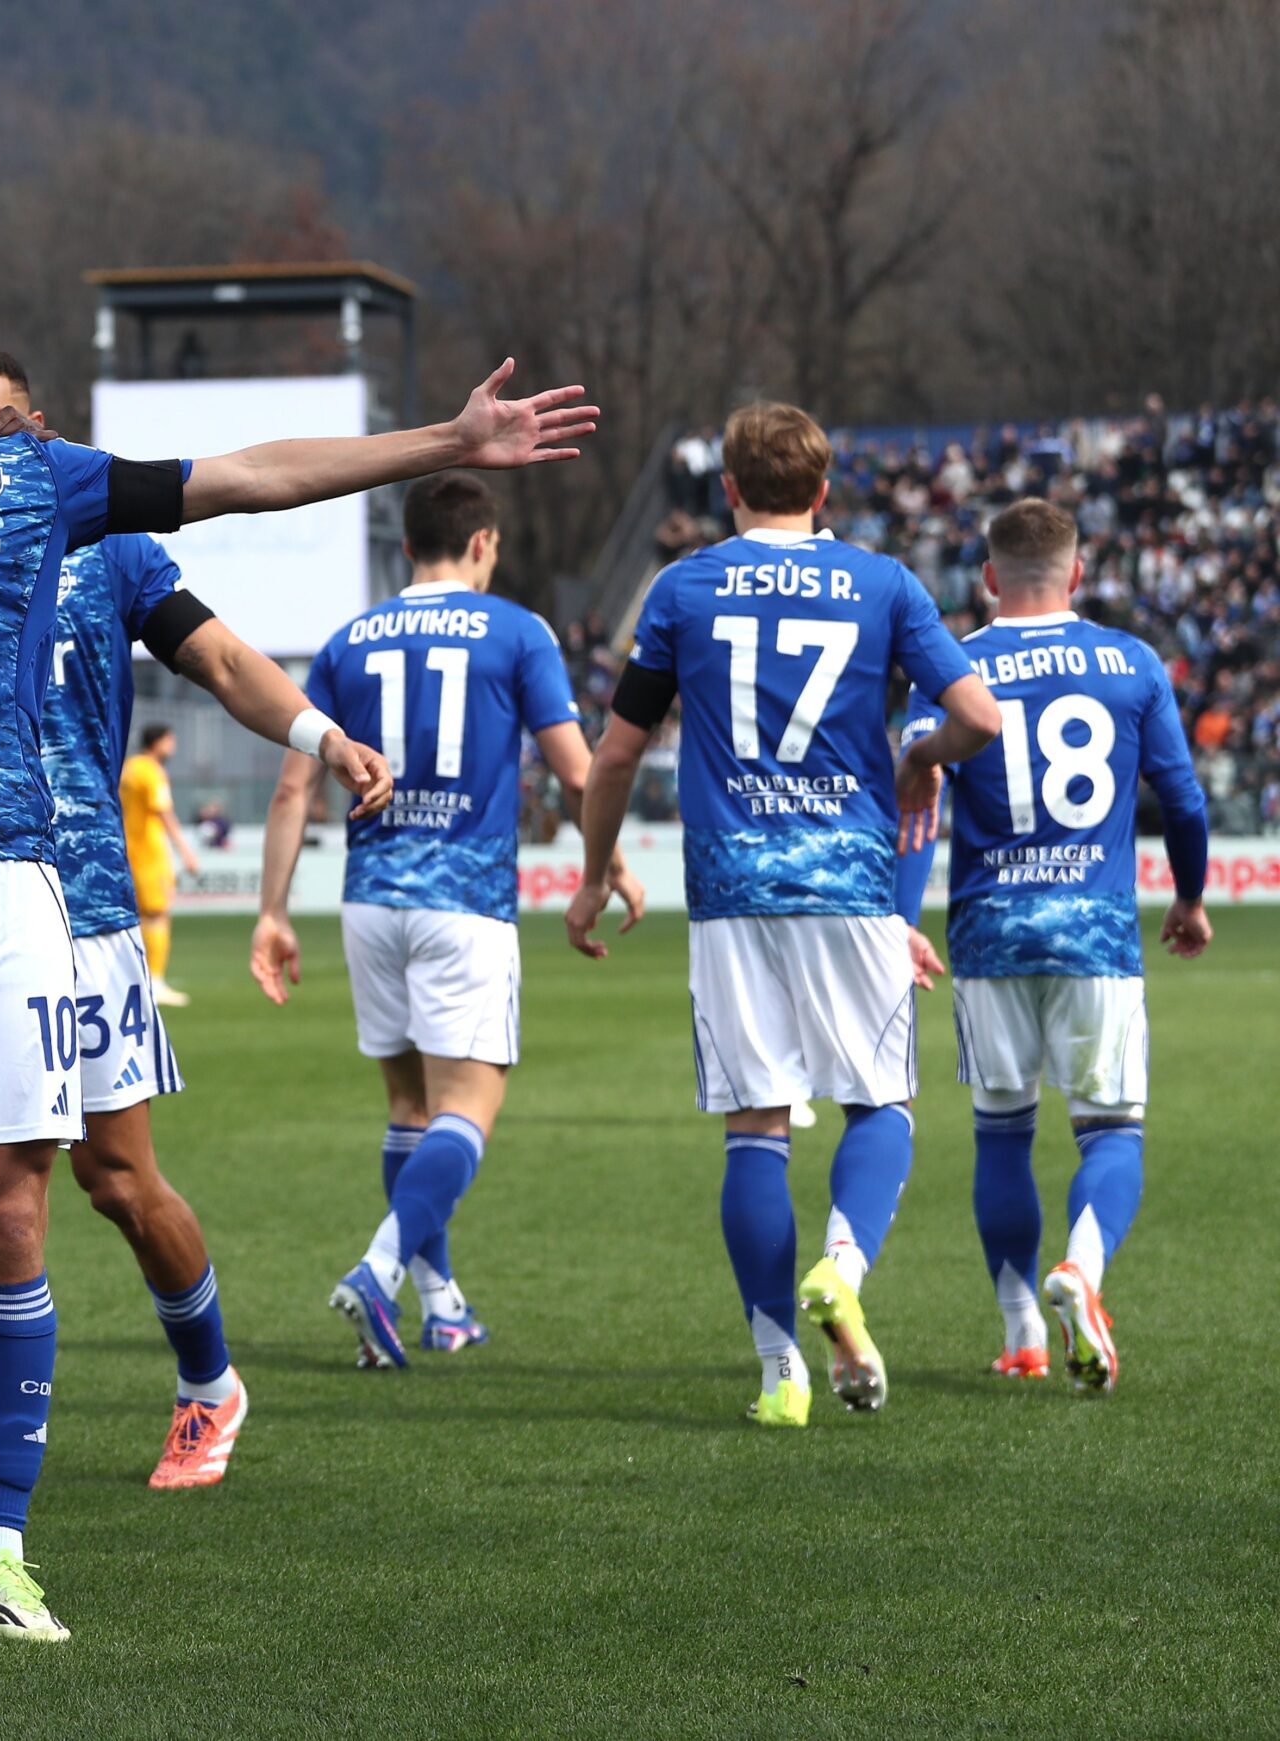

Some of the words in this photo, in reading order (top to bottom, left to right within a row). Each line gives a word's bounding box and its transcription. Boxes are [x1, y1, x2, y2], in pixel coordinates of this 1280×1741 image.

[830, 569, 861, 601] R.
[348, 609, 490, 645] DOUVIKAS
[712, 615, 859, 763] 17
[364, 647, 470, 778] 11
[995, 694, 1116, 835] 18
[726, 774, 861, 795] NEUBERGER
[394, 790, 472, 811] BERGER
[750, 798, 843, 817] BERMAN
[381, 810, 453, 830] ERMAN
[982, 844, 1106, 867] NEUBERGER
[996, 867, 1086, 885] BERMAN
[27, 995, 77, 1072] 10
[76, 984, 147, 1059] 34
[19, 1380, 51, 1397] CO
